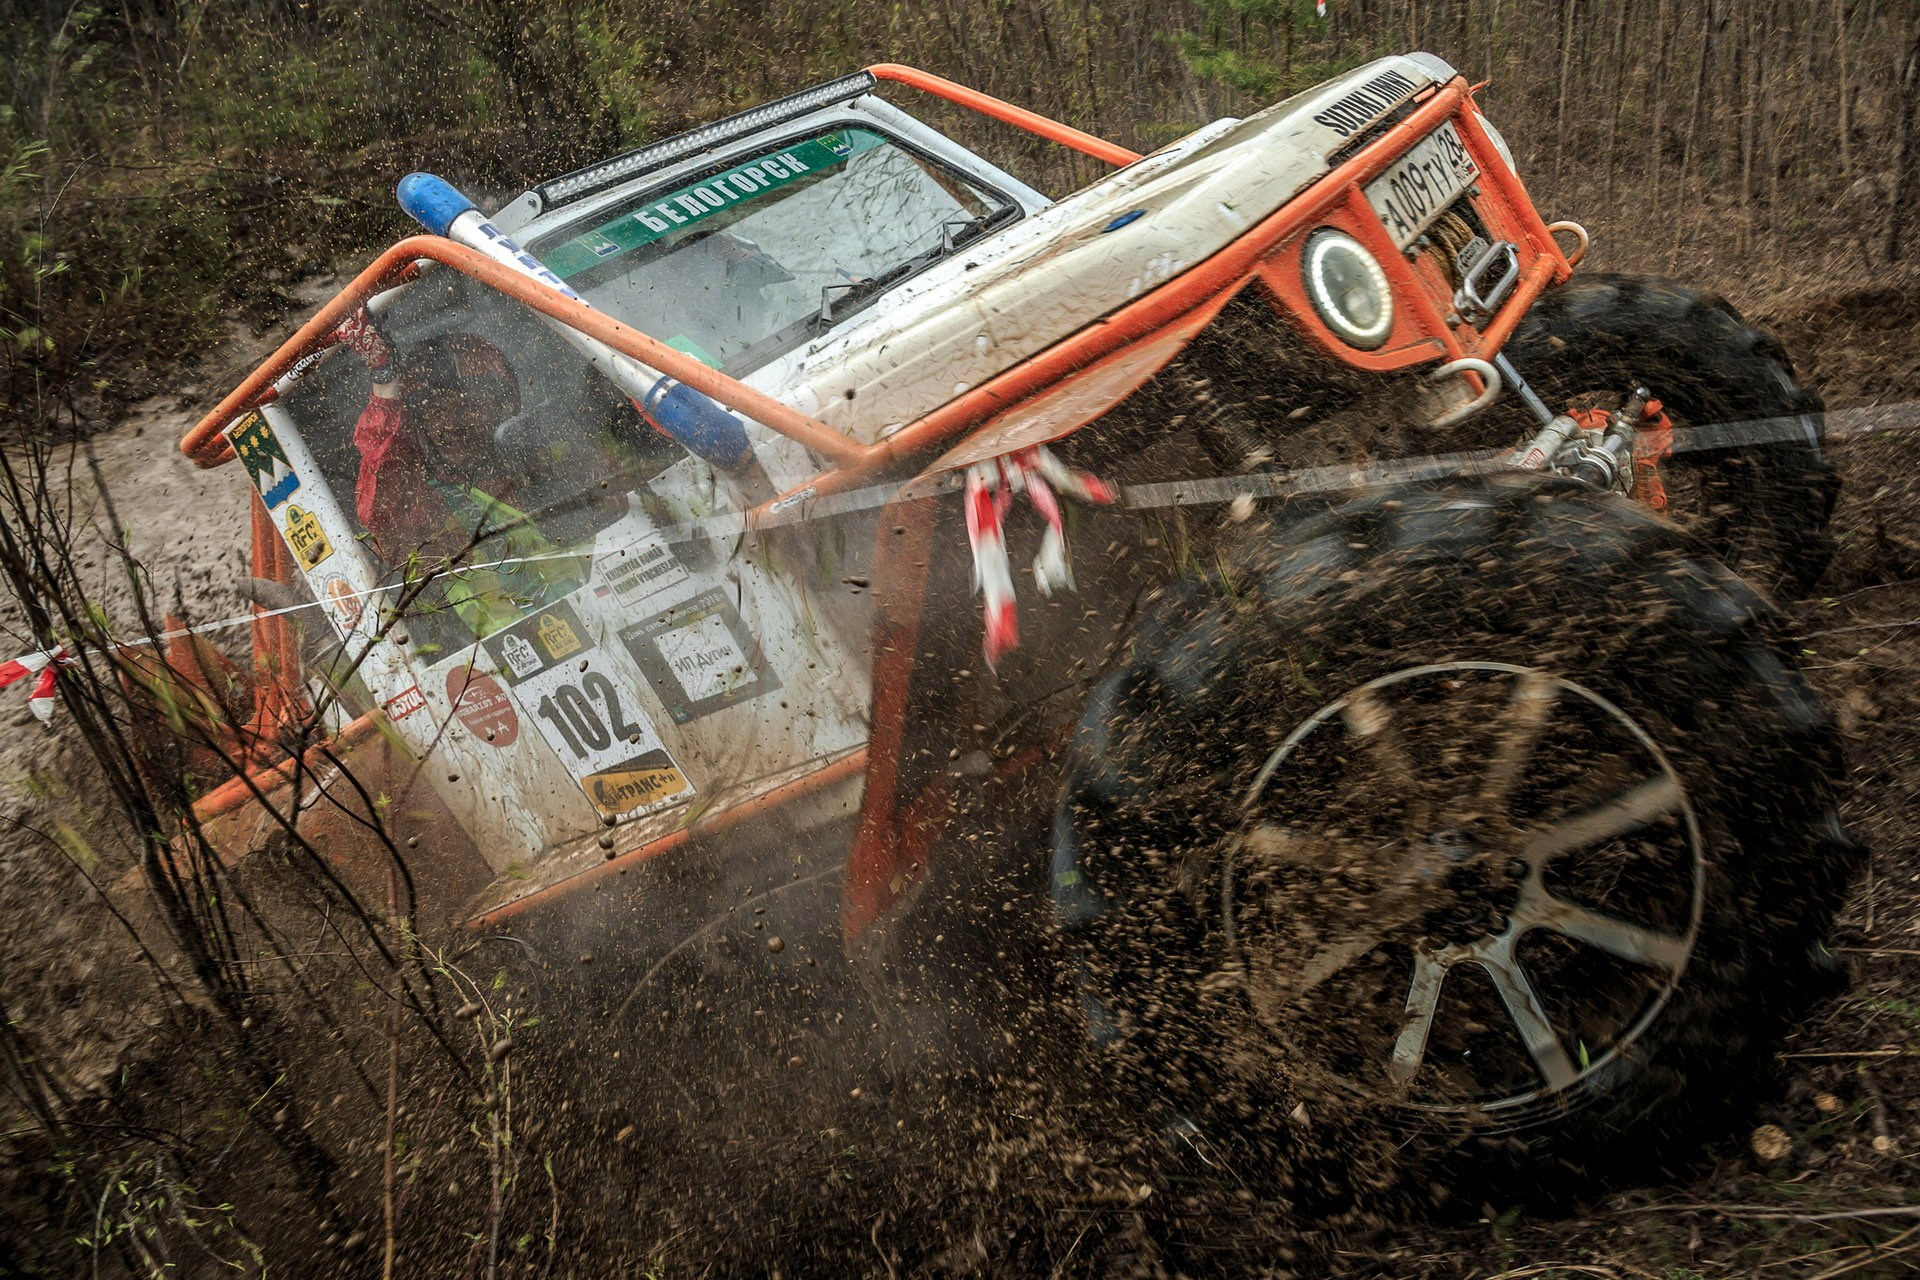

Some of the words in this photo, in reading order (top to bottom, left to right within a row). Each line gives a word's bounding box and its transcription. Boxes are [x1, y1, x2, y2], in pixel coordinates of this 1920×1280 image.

[1313, 90, 1387, 136] SUZUKI
[1361, 69, 1417, 104] JIMNY
[1438, 128, 1464, 168] 28
[632, 152, 811, 233] БЕЛОГОРСК
[675, 656, 696, 672] ИП
[537, 671, 643, 761] 102
